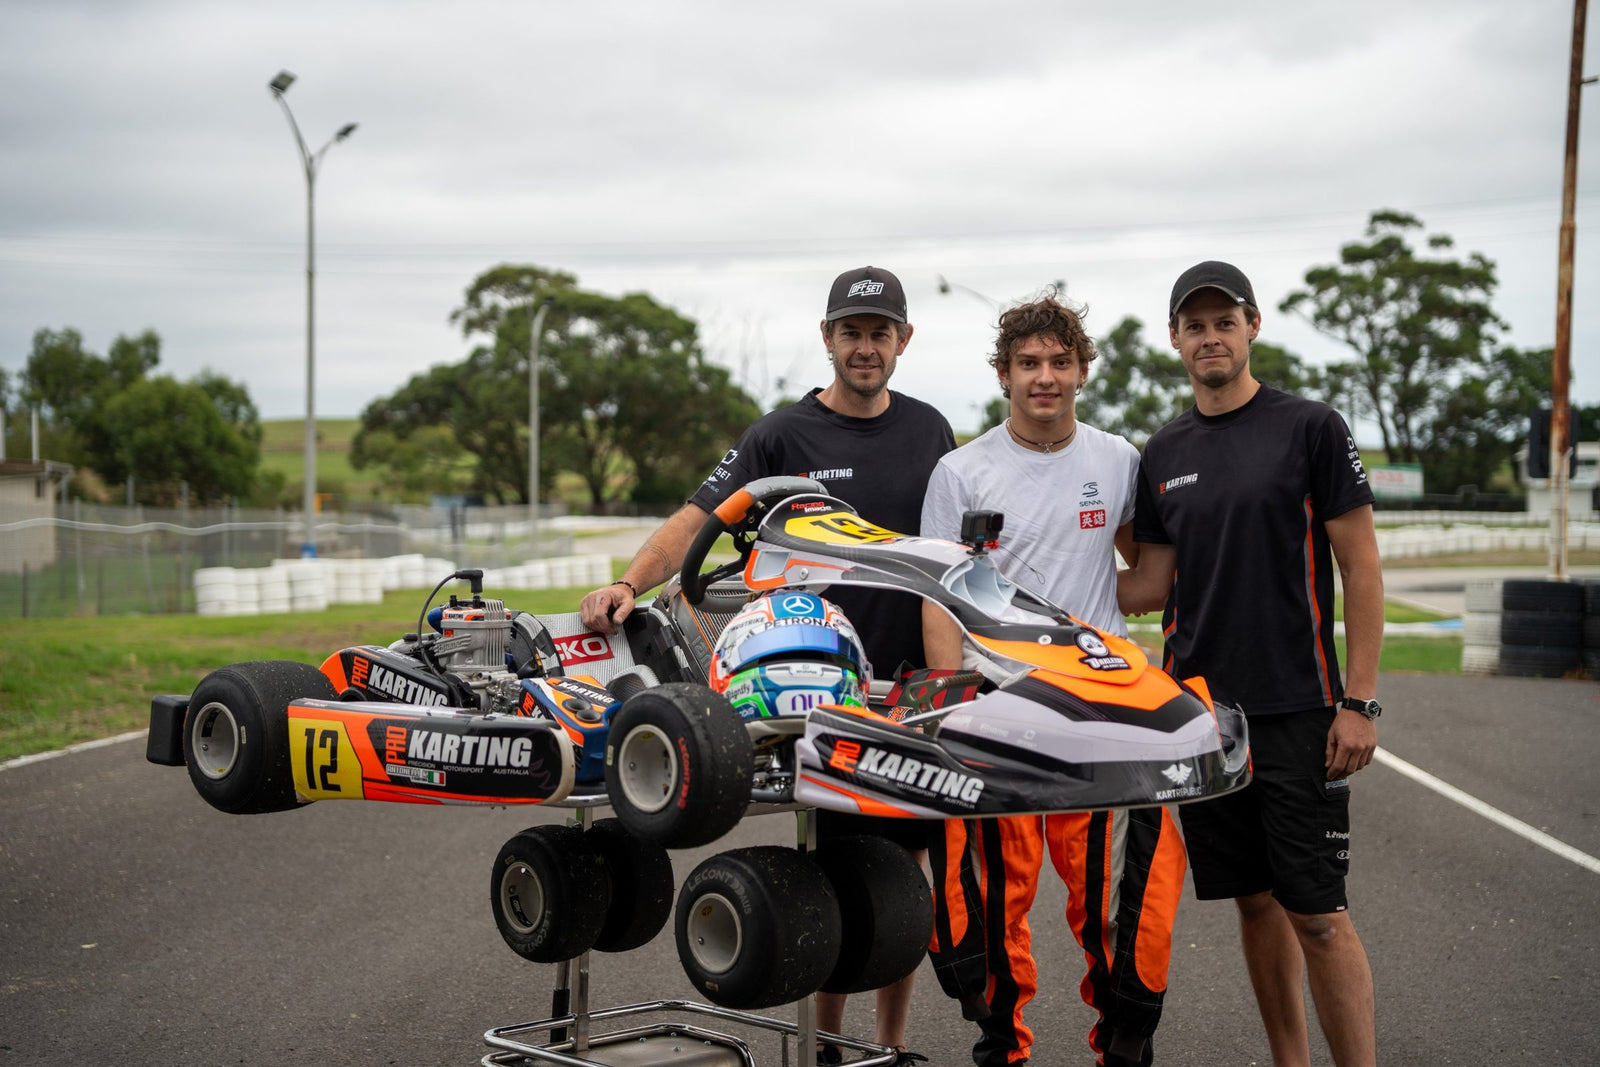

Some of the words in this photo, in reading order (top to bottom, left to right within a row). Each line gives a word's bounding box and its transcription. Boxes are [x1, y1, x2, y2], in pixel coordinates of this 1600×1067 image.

[808, 468, 853, 480] KARTING
[1165, 473, 1199, 490] KARTING
[791, 502, 825, 511] Racing
[1081, 511, 1105, 528] 英雄
[764, 616, 840, 633] PETRONAS
[368, 664, 448, 708] KARTING
[558, 681, 616, 704] KARTING
[385, 725, 407, 765] PRO
[408, 729, 533, 768] KARTING
[304, 727, 342, 792] 12
[407, 759, 436, 769] PRECISION
[442, 764, 485, 774] MOTORSPORT
[493, 768, 530, 776] AUSTRALIA
[829, 739, 862, 774] PRO
[858, 747, 985, 804] KARTING
[687, 867, 734, 892] LECONT
